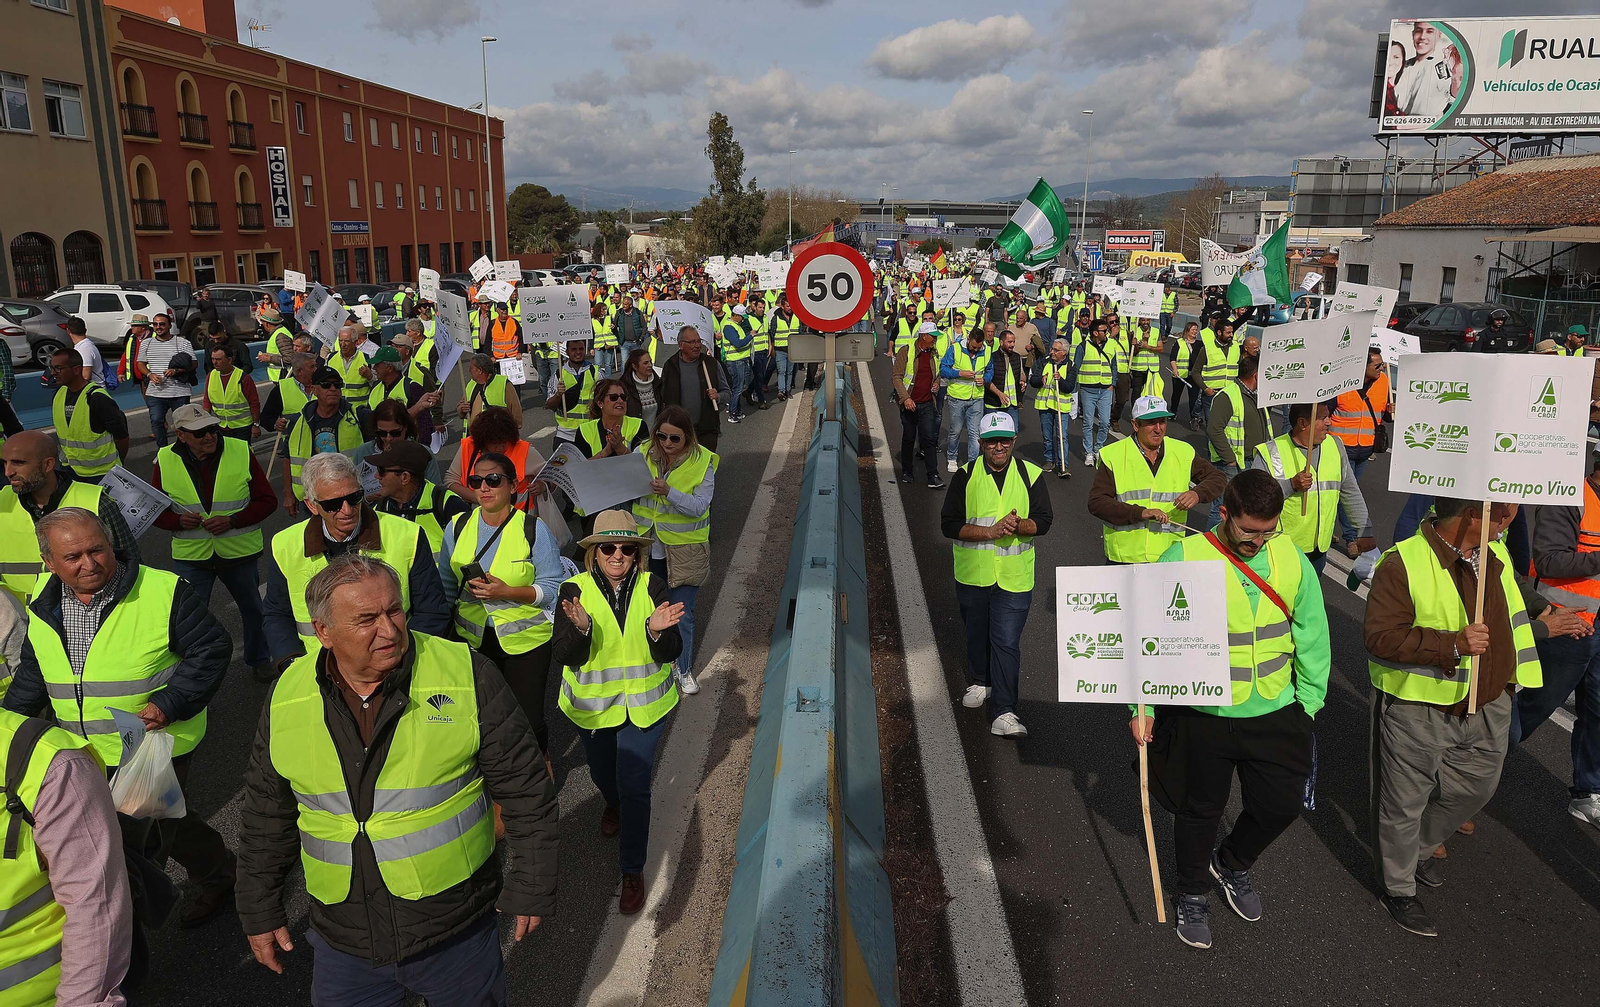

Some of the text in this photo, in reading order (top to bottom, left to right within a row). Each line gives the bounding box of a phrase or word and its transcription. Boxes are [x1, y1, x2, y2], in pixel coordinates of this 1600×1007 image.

[1483, 79, 1544, 92] Vehículos
[1547, 79, 1563, 91] de
[1455, 117, 1469, 126] POL.
[1470, 117, 1483, 126] IND.
[1484, 117, 1492, 126] LA
[1493, 117, 1525, 126] MENACHA
[1530, 117, 1540, 125] AV.
[1541, 117, 1553, 125] DEL
[1554, 116, 1587, 125] ESTRECHO
[268, 149, 288, 218] HOSTAL
[342, 234, 369, 246] BLUMEN
[1108, 236, 1150, 244] OBRAMAT
[807, 272, 854, 302] 50
[559, 327, 592, 337] Campo Vivo
[1286, 362, 1305, 370] UPA
[1316, 378, 1360, 398] Campo Vivo
[1409, 380, 1470, 393] COAG
[1269, 391, 1297, 401] Por un
[1531, 405, 1557, 413] ASAJA
[1439, 424, 1469, 437] UPA
[1518, 433, 1566, 442] cooperativas
[1409, 470, 1456, 488] Por un
[1487, 477, 1577, 498] Campo Vivo
[1067, 593, 1118, 605] COAG
[1098, 633, 1123, 644] UPA
[1160, 636, 1204, 644] cooperativas
[1076, 680, 1118, 694] Por un
[1142, 680, 1224, 699] Campo Vivo
[427, 714, 453, 722] Unicaja
